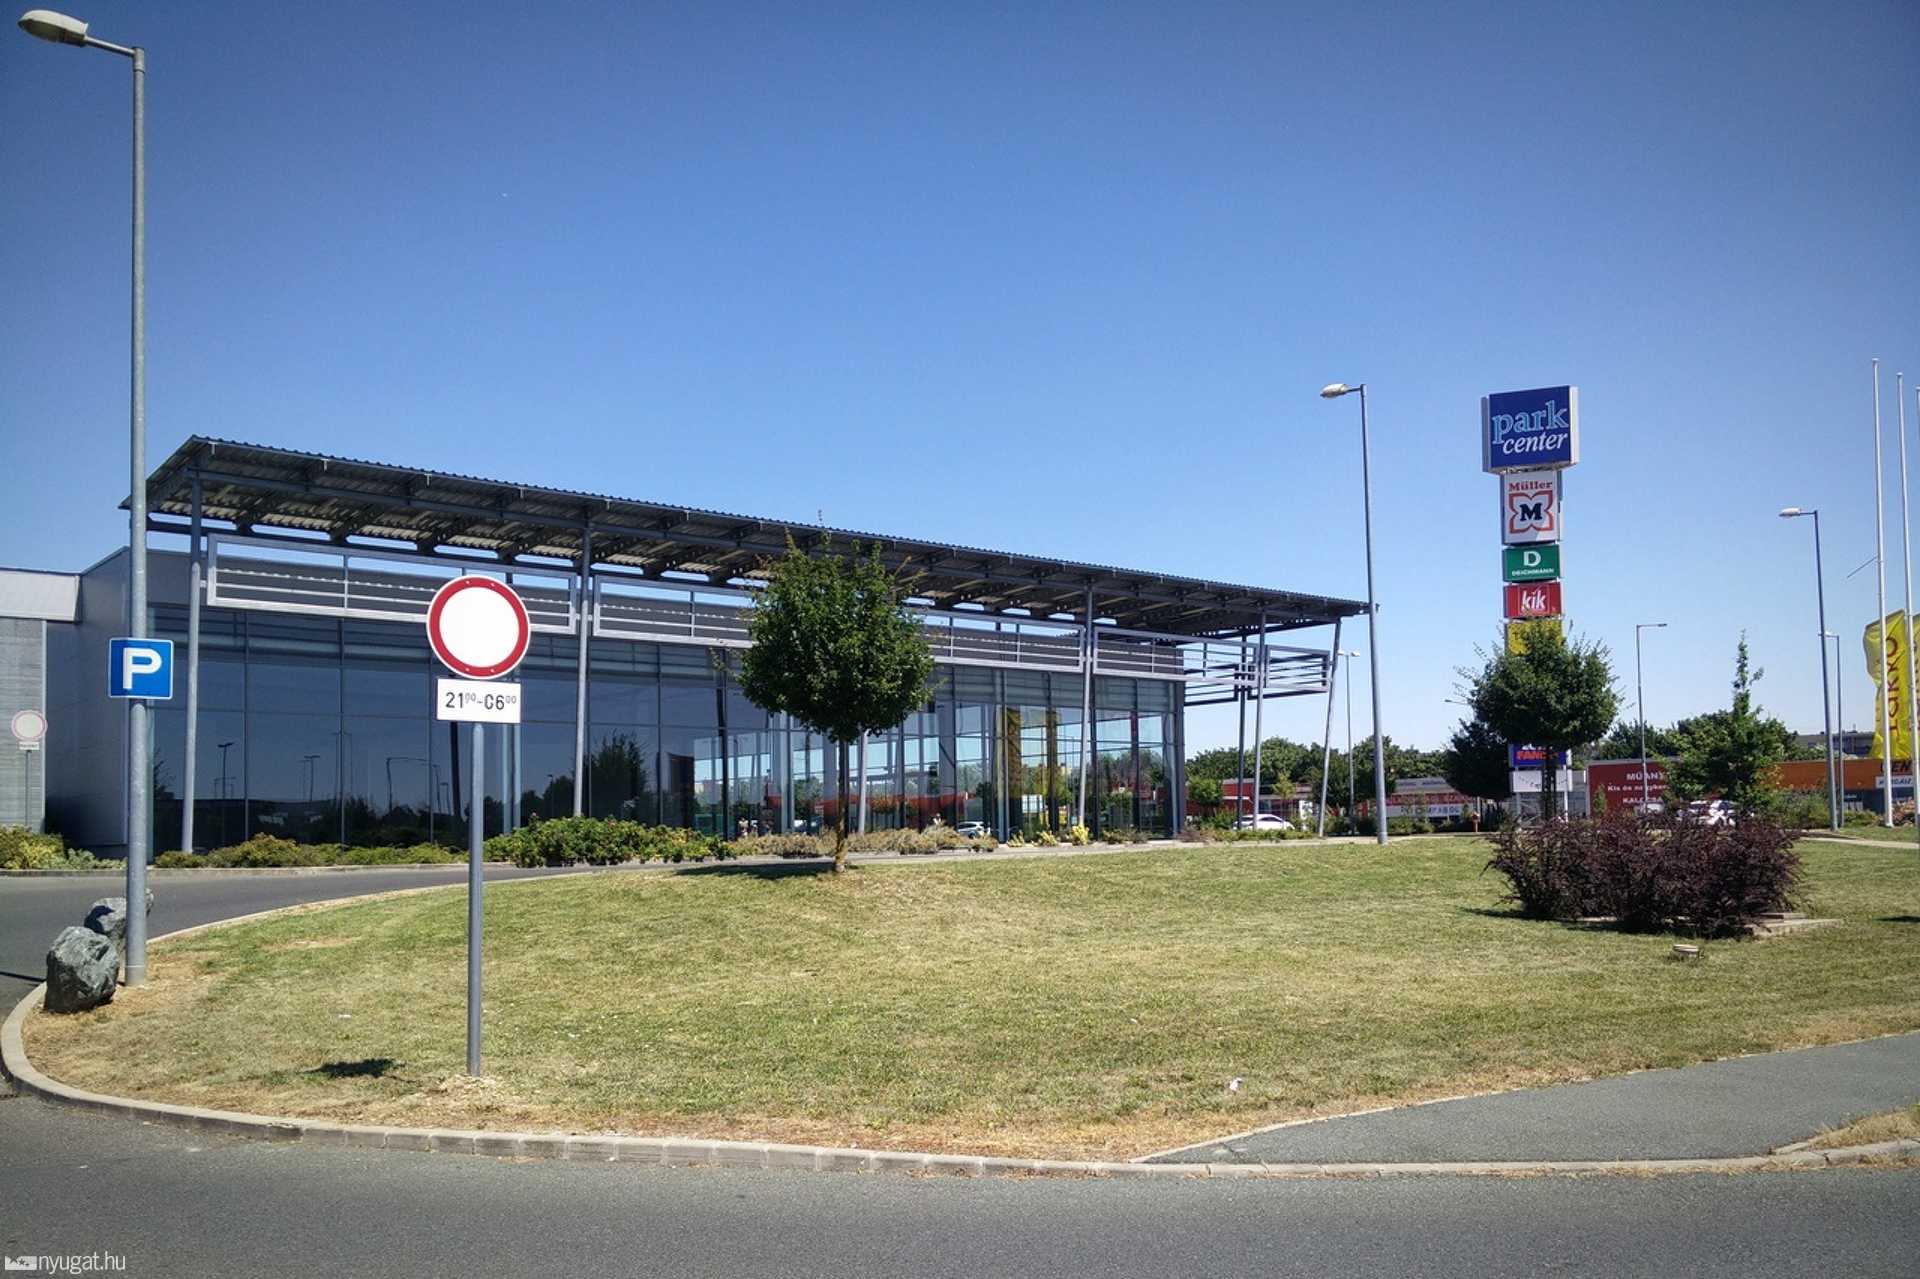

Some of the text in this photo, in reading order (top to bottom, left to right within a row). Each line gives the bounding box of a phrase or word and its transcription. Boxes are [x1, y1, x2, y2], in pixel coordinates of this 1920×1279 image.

[1492, 400, 1569, 445] park
[1503, 431, 1568, 455] center
[1509, 480, 1553, 492] Müller
[1519, 502, 1543, 521] M
[1523, 551, 1542, 567] D
[1511, 567, 1554, 577] DEICHMANN
[122, 646, 163, 690] P
